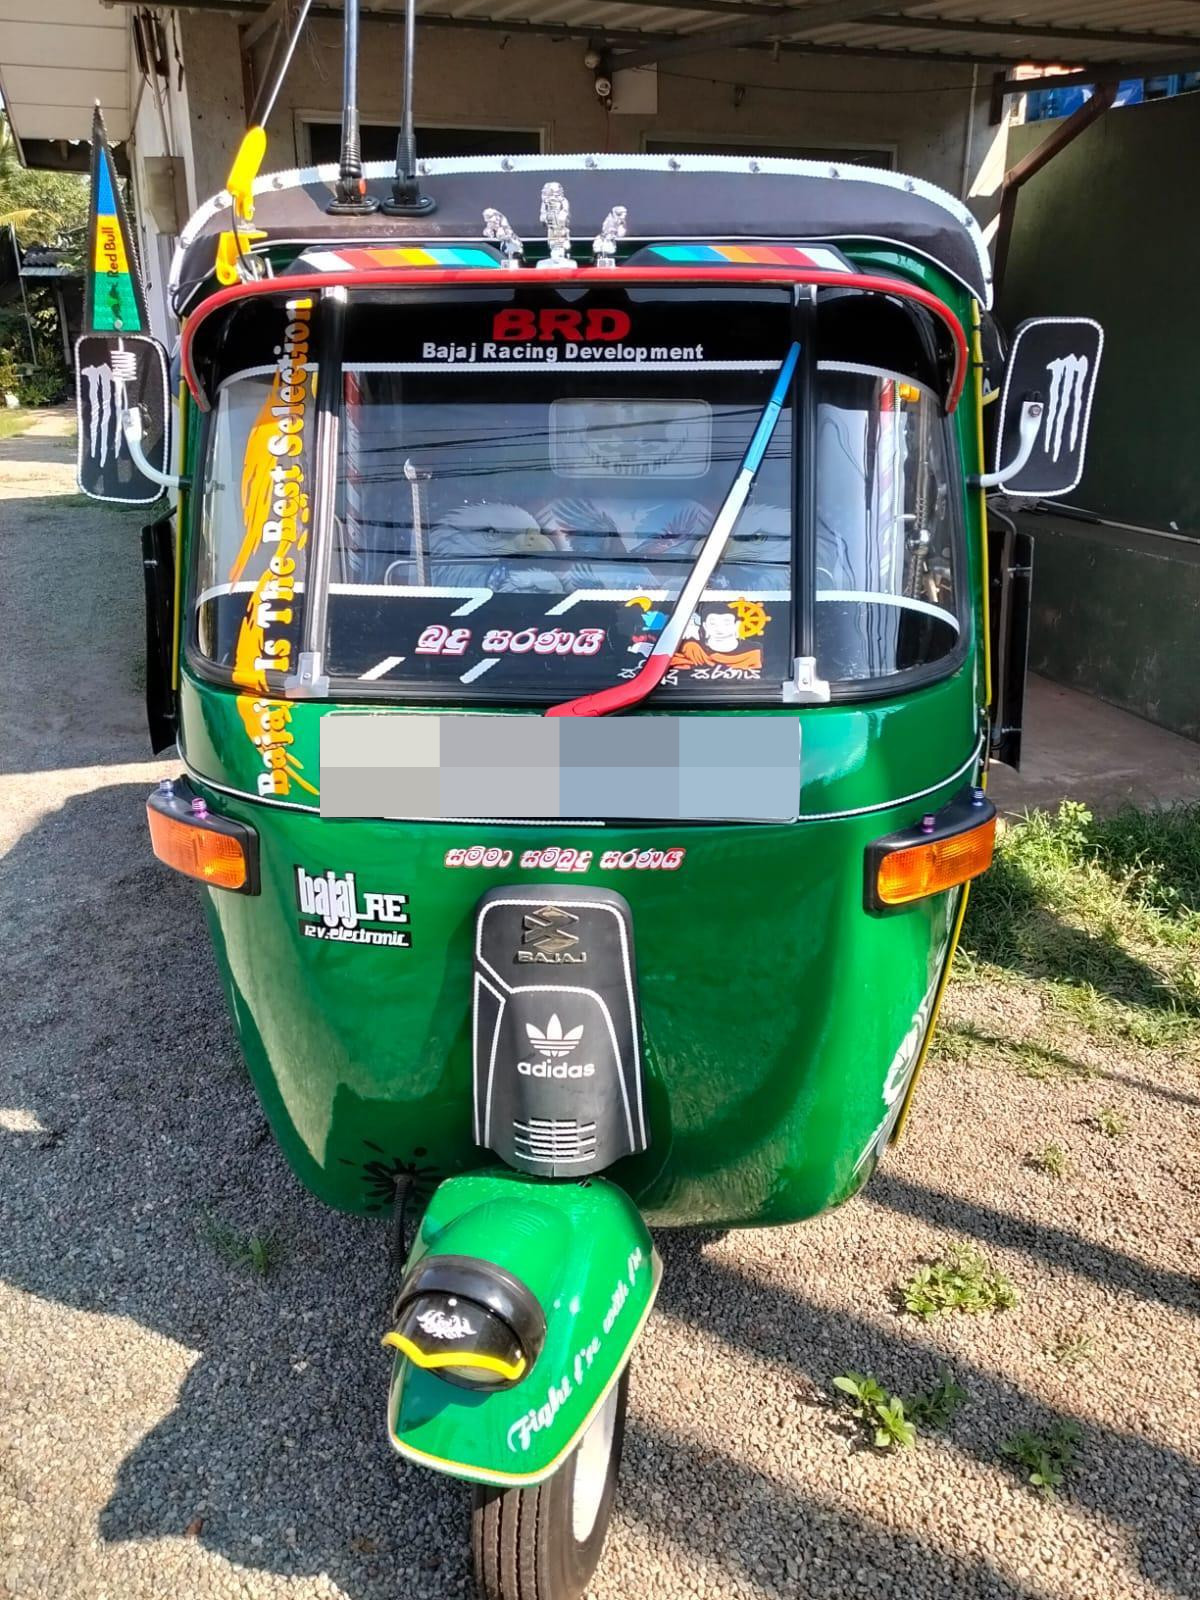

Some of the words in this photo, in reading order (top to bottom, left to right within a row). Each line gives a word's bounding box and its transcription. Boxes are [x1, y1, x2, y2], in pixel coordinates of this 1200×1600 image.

[101, 226, 116, 251] Bull
[107, 253, 119, 278] Red
[492, 308, 632, 342] BRD
[422, 342, 477, 363] Bajaj
[483, 343, 559, 364] Racing
[565, 343, 704, 363] Development
[267, 298, 313, 458] Selection
[262, 464, 305, 543] Best
[256, 555, 297, 629] The
[254, 638, 292, 673] Is
[297, 867, 359, 929] bajaj
[363, 892, 408, 922] RE
[517, 950, 588, 965] BAJAJ
[517, 1059, 596, 1079] adidas
[507, 1375, 573, 1453] Fight
